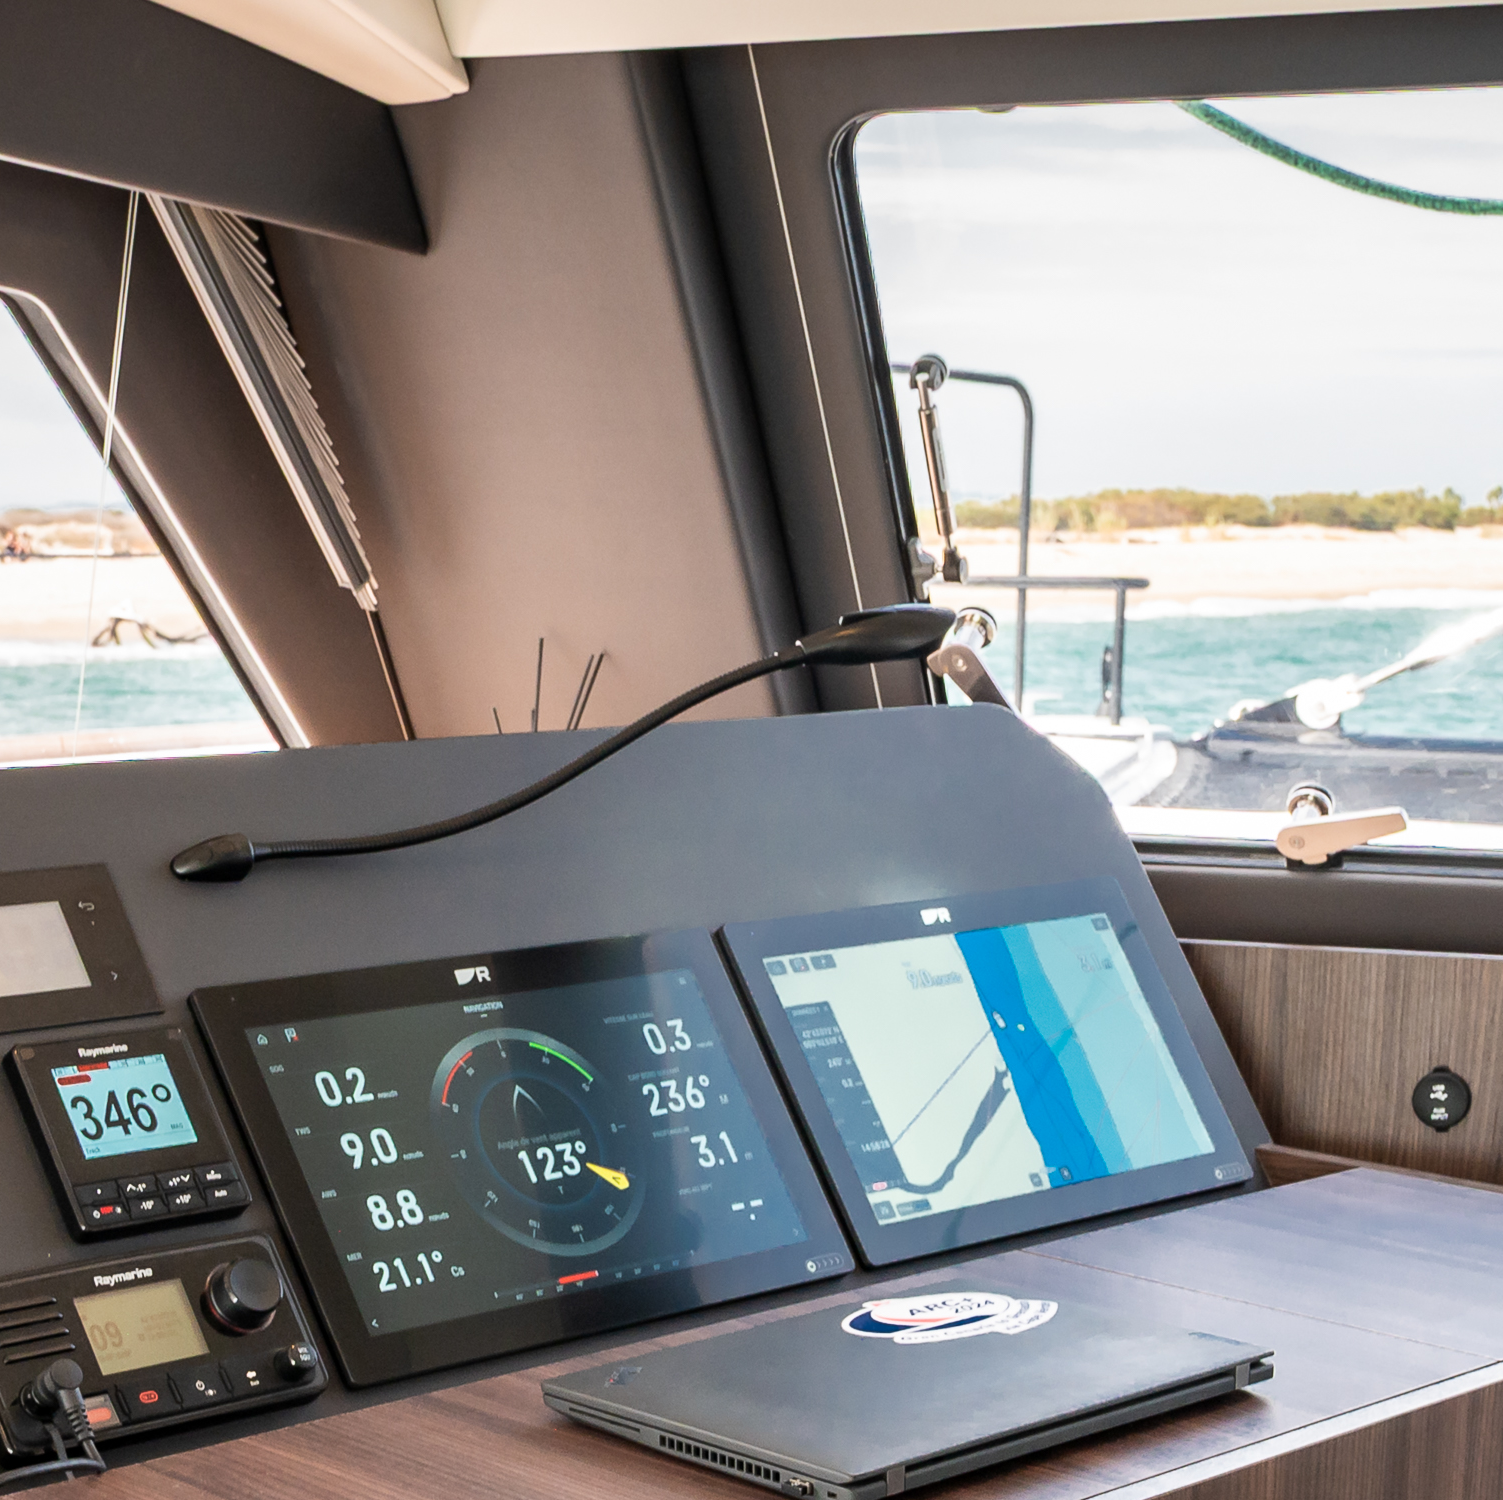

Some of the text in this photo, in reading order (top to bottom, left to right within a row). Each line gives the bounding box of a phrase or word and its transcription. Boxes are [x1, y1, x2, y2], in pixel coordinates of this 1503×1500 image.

[463, 1001, 503, 1013] NAVIGATION
[77, 1043, 128, 1058] Raymarine
[642, 1018, 692, 1055] 0.3
[314, 1067, 375, 1107] 0.2
[642, 1074, 710, 1117] 236°
[70, 1083, 172, 1141] 346°
[340, 1127, 398, 1169] 9.0
[518, 1140, 587, 1184] 123°
[690, 1130, 738, 1168] 3.1
[366, 1189, 424, 1231] 8.8
[93, 1267, 153, 1288] Raymarine
[372, 1250, 443, 1293] 21.1°
[908, 1297, 972, 1316] ARC+
[953, 1299, 995, 1314] 2024
[89, 1320, 124, 1352] 09
